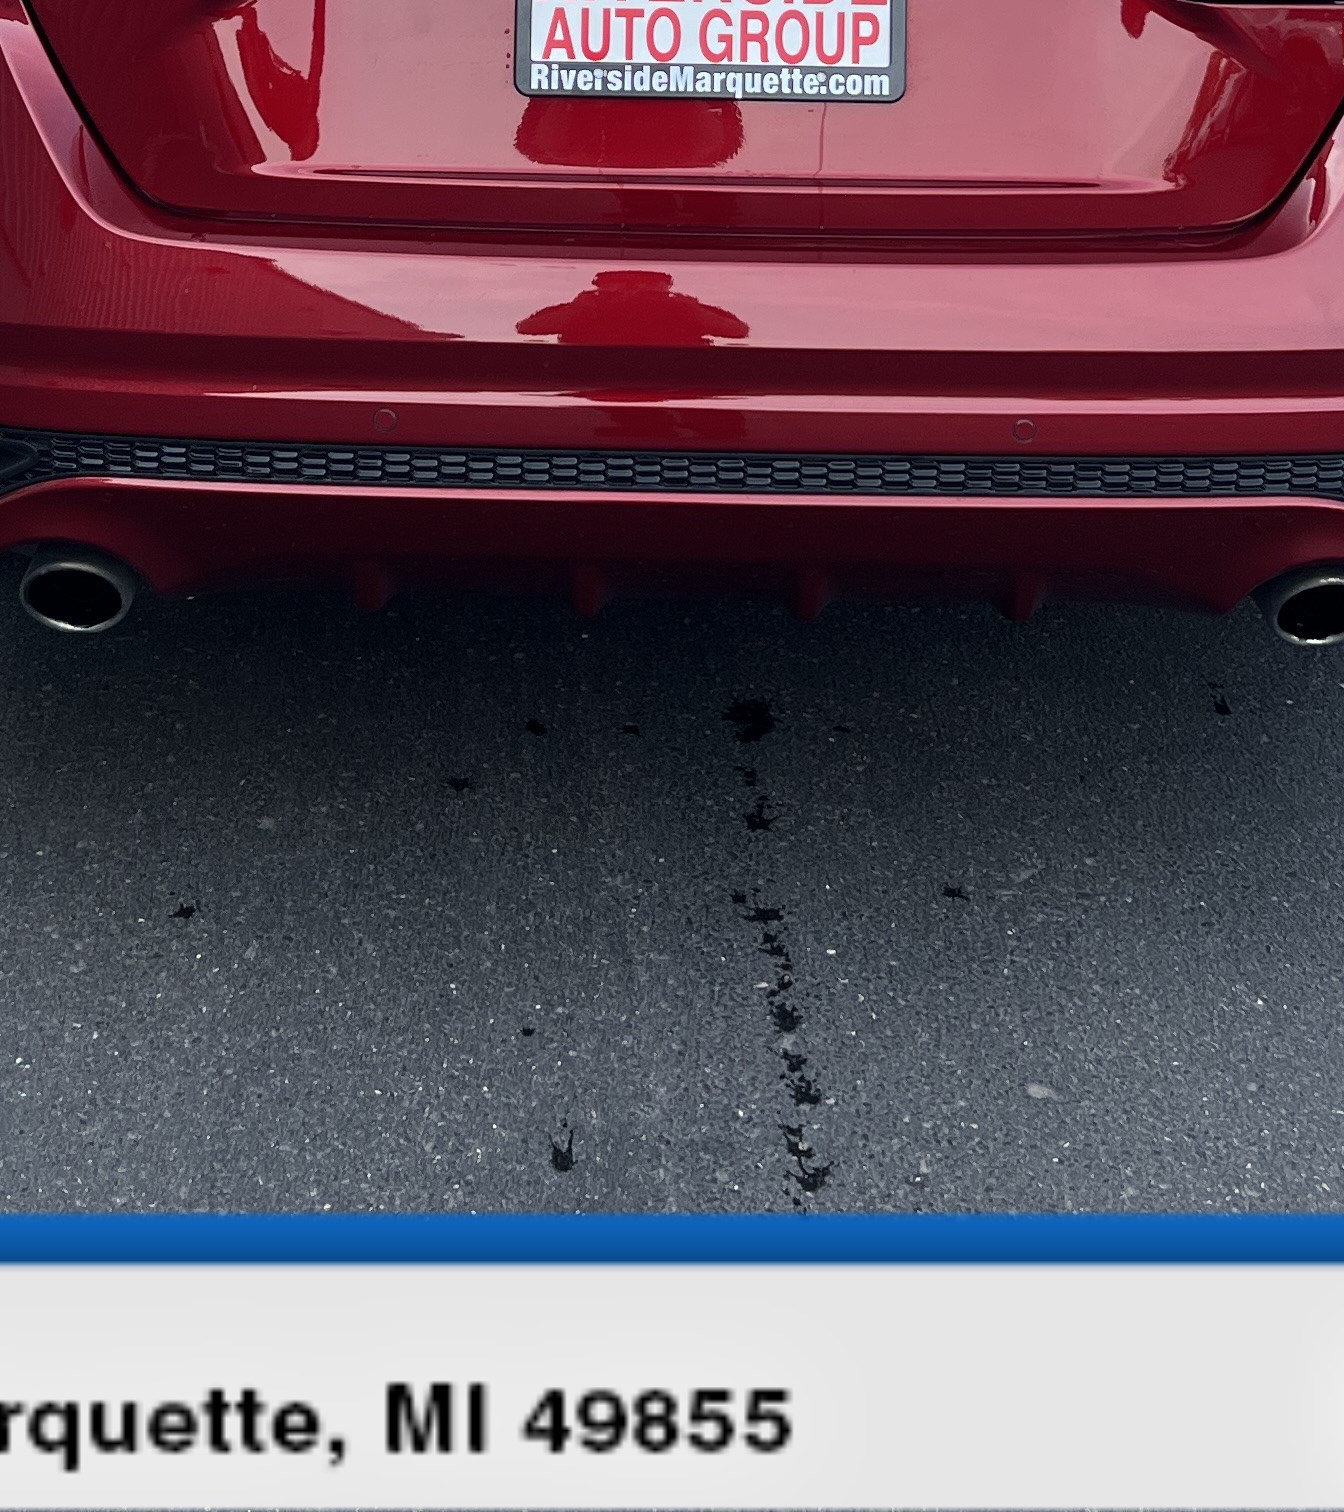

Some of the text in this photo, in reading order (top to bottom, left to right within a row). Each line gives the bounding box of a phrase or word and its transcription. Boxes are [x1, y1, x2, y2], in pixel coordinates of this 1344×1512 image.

[542, 7, 881, 65] AUTO GROUP
[530, 64, 891, 99] RiversideMarquette.com
